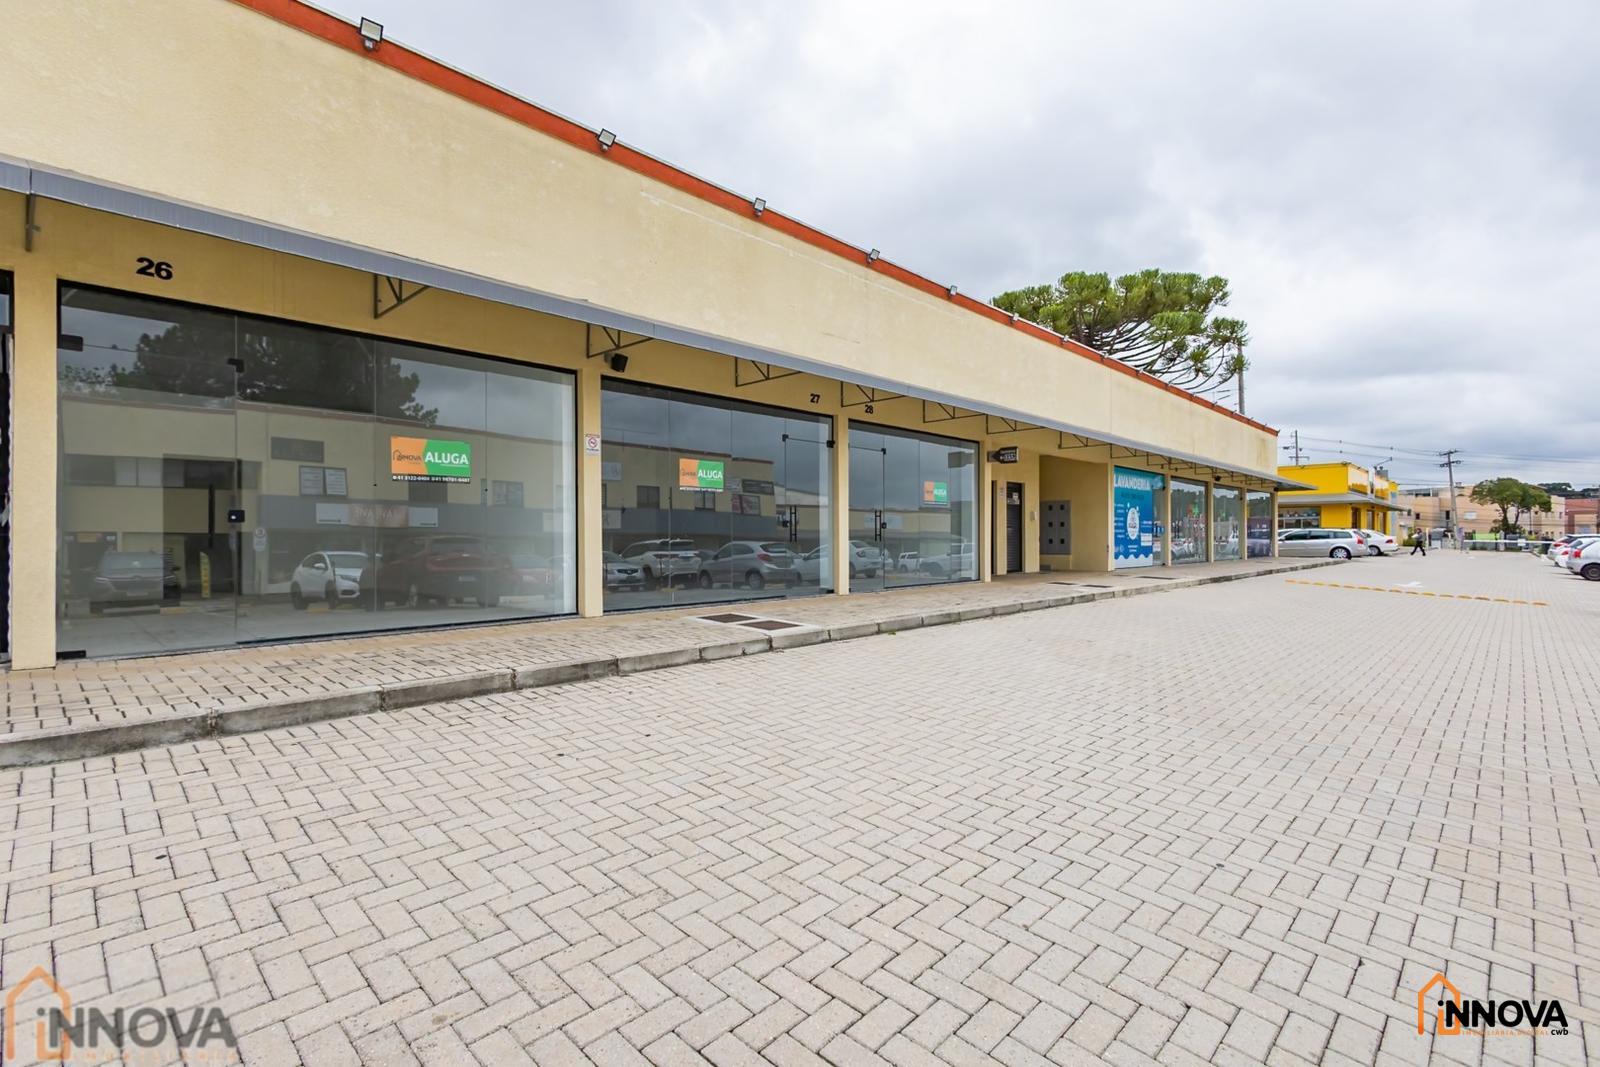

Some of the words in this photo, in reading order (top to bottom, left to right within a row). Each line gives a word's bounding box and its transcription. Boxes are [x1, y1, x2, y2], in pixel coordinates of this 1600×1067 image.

[136, 256, 173, 281] 26
[810, 393, 821, 404] 27
[864, 404, 875, 415] 28
[424, 451, 469, 464] ALUGA
[698, 469, 723, 479] ALUGA
